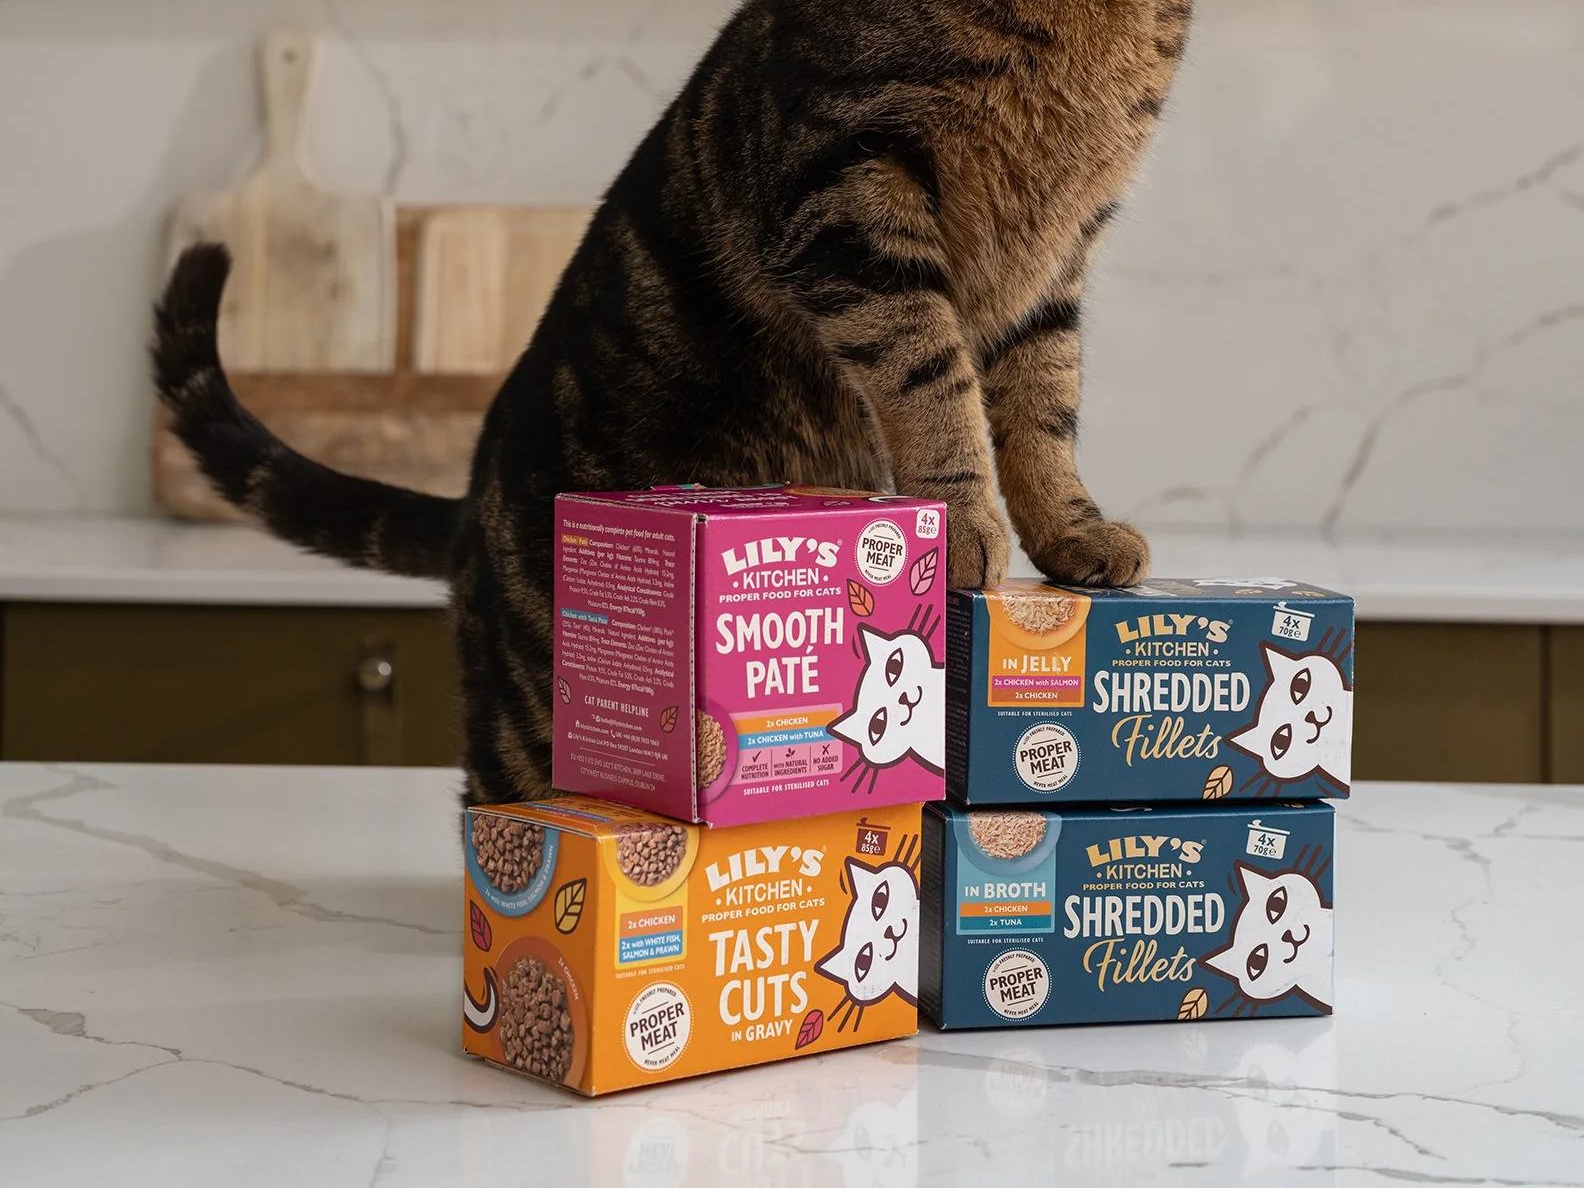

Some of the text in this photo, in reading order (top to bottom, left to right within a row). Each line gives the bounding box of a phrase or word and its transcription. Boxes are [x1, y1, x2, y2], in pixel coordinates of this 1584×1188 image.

[921, 513, 935, 525] 4x
[721, 537, 840, 575] LILY'S
[862, 537, 903, 556] PROPER
[866, 551, 895, 567] MEAT
[743, 568, 819, 589] KITCHEN
[719, 587, 841, 603] PROPER FOOD FOR CATS
[716, 607, 844, 654] SMOOTH
[1115, 613, 1231, 643] LILY'S
[1283, 615, 1301, 629] 4x
[1135, 642, 1209, 657] KITCHEN
[746, 645, 819, 699] PATÉ
[1003, 654, 1072, 674] IN JELLY
[1112, 659, 1151, 667] PROPER
[1153, 659, 1182, 667] FOOD
[1205, 659, 1231, 667] CATS
[1092, 670, 1250, 713] SHREDDED
[584, 695, 649, 717] CAT PARENT HELPLINE
[776, 717, 808, 727] CHICKEN
[748, 737, 756, 745] 2x
[758, 735, 788, 744] CHICKEN
[804, 731, 823, 739] TUNA
[1111, 714, 1222, 767] Fillets
[813, 757, 821, 765] NO
[1020, 741, 1072, 762] PROPER
[742, 763, 768, 772] COMPLETE
[774, 767, 807, 776] INGREDIENTS
[785, 759, 807, 767] NATURAL
[818, 763, 834, 771] SUGAR
[1030, 755, 1065, 774] MEAT
[741, 771, 769, 780] NUTRITION
[743, 786, 770, 796] SUITABLE
[772, 784, 782, 792] FOR
[816, 779, 829, 787] CATS
[864, 831, 879, 845] 4x
[1257, 833, 1276, 847] 4x
[1086, 835, 1204, 867] LILY'S
[705, 846, 825, 892] LILY'S
[1106, 863, 1182, 880] KITCHEN
[726, 878, 803, 907] KITCHEN
[964, 882, 1046, 899] IN BROTH
[1083, 880, 1205, 891] PROPER FOOD FOR CATS
[702, 898, 825, 923] PROPER FOOD FOR CATS
[1063, 892, 1225, 939] SHREDDED
[628, 914, 676, 930] 2x CHICKEN
[621, 942, 631, 950] 2x
[632, 940, 644, 948] with
[645, 936, 665, 947] WHITE
[623, 949, 649, 960] SALMON
[656, 945, 679, 955] PRAWN
[709, 919, 819, 977] TASTY
[1083, 938, 1197, 992] Fillets
[564, 966, 579, 1001] CHICKEN
[989, 967, 1043, 990] PROPER
[719, 971, 809, 1026] CUTS
[1000, 982, 1036, 1003] MEAT
[630, 1002, 685, 1037] PROPER
[641, 1021, 678, 1051] MEAT
[731, 1019, 793, 1042] IN GRAVY
